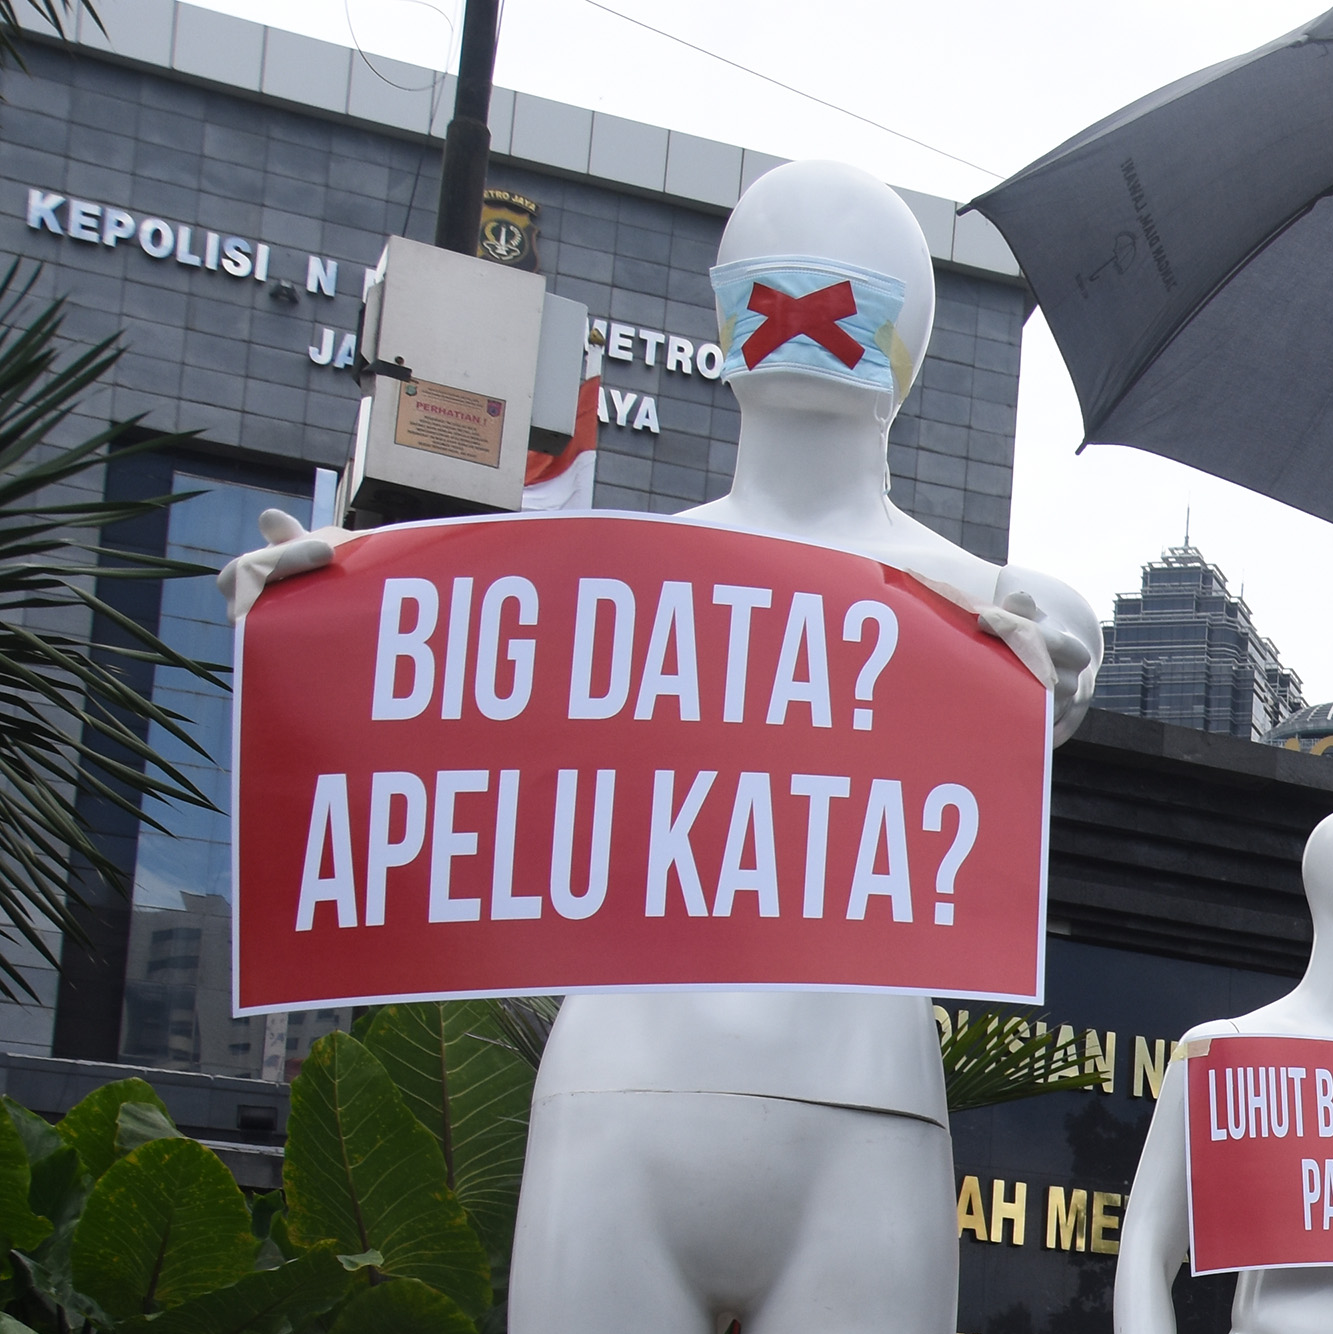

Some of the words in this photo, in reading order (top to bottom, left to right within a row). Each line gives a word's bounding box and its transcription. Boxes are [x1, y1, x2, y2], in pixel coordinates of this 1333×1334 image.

[483, 189, 510, 200] ETRO
[371, 575, 539, 722] BIG
[568, 577, 899, 731] DATA?
[644, 771, 980, 927] KATA?
[1208, 1065, 1306, 1142] LUHUT
[957, 1175, 1027, 1246] AH
[1046, 1185, 1130, 1255] ME
